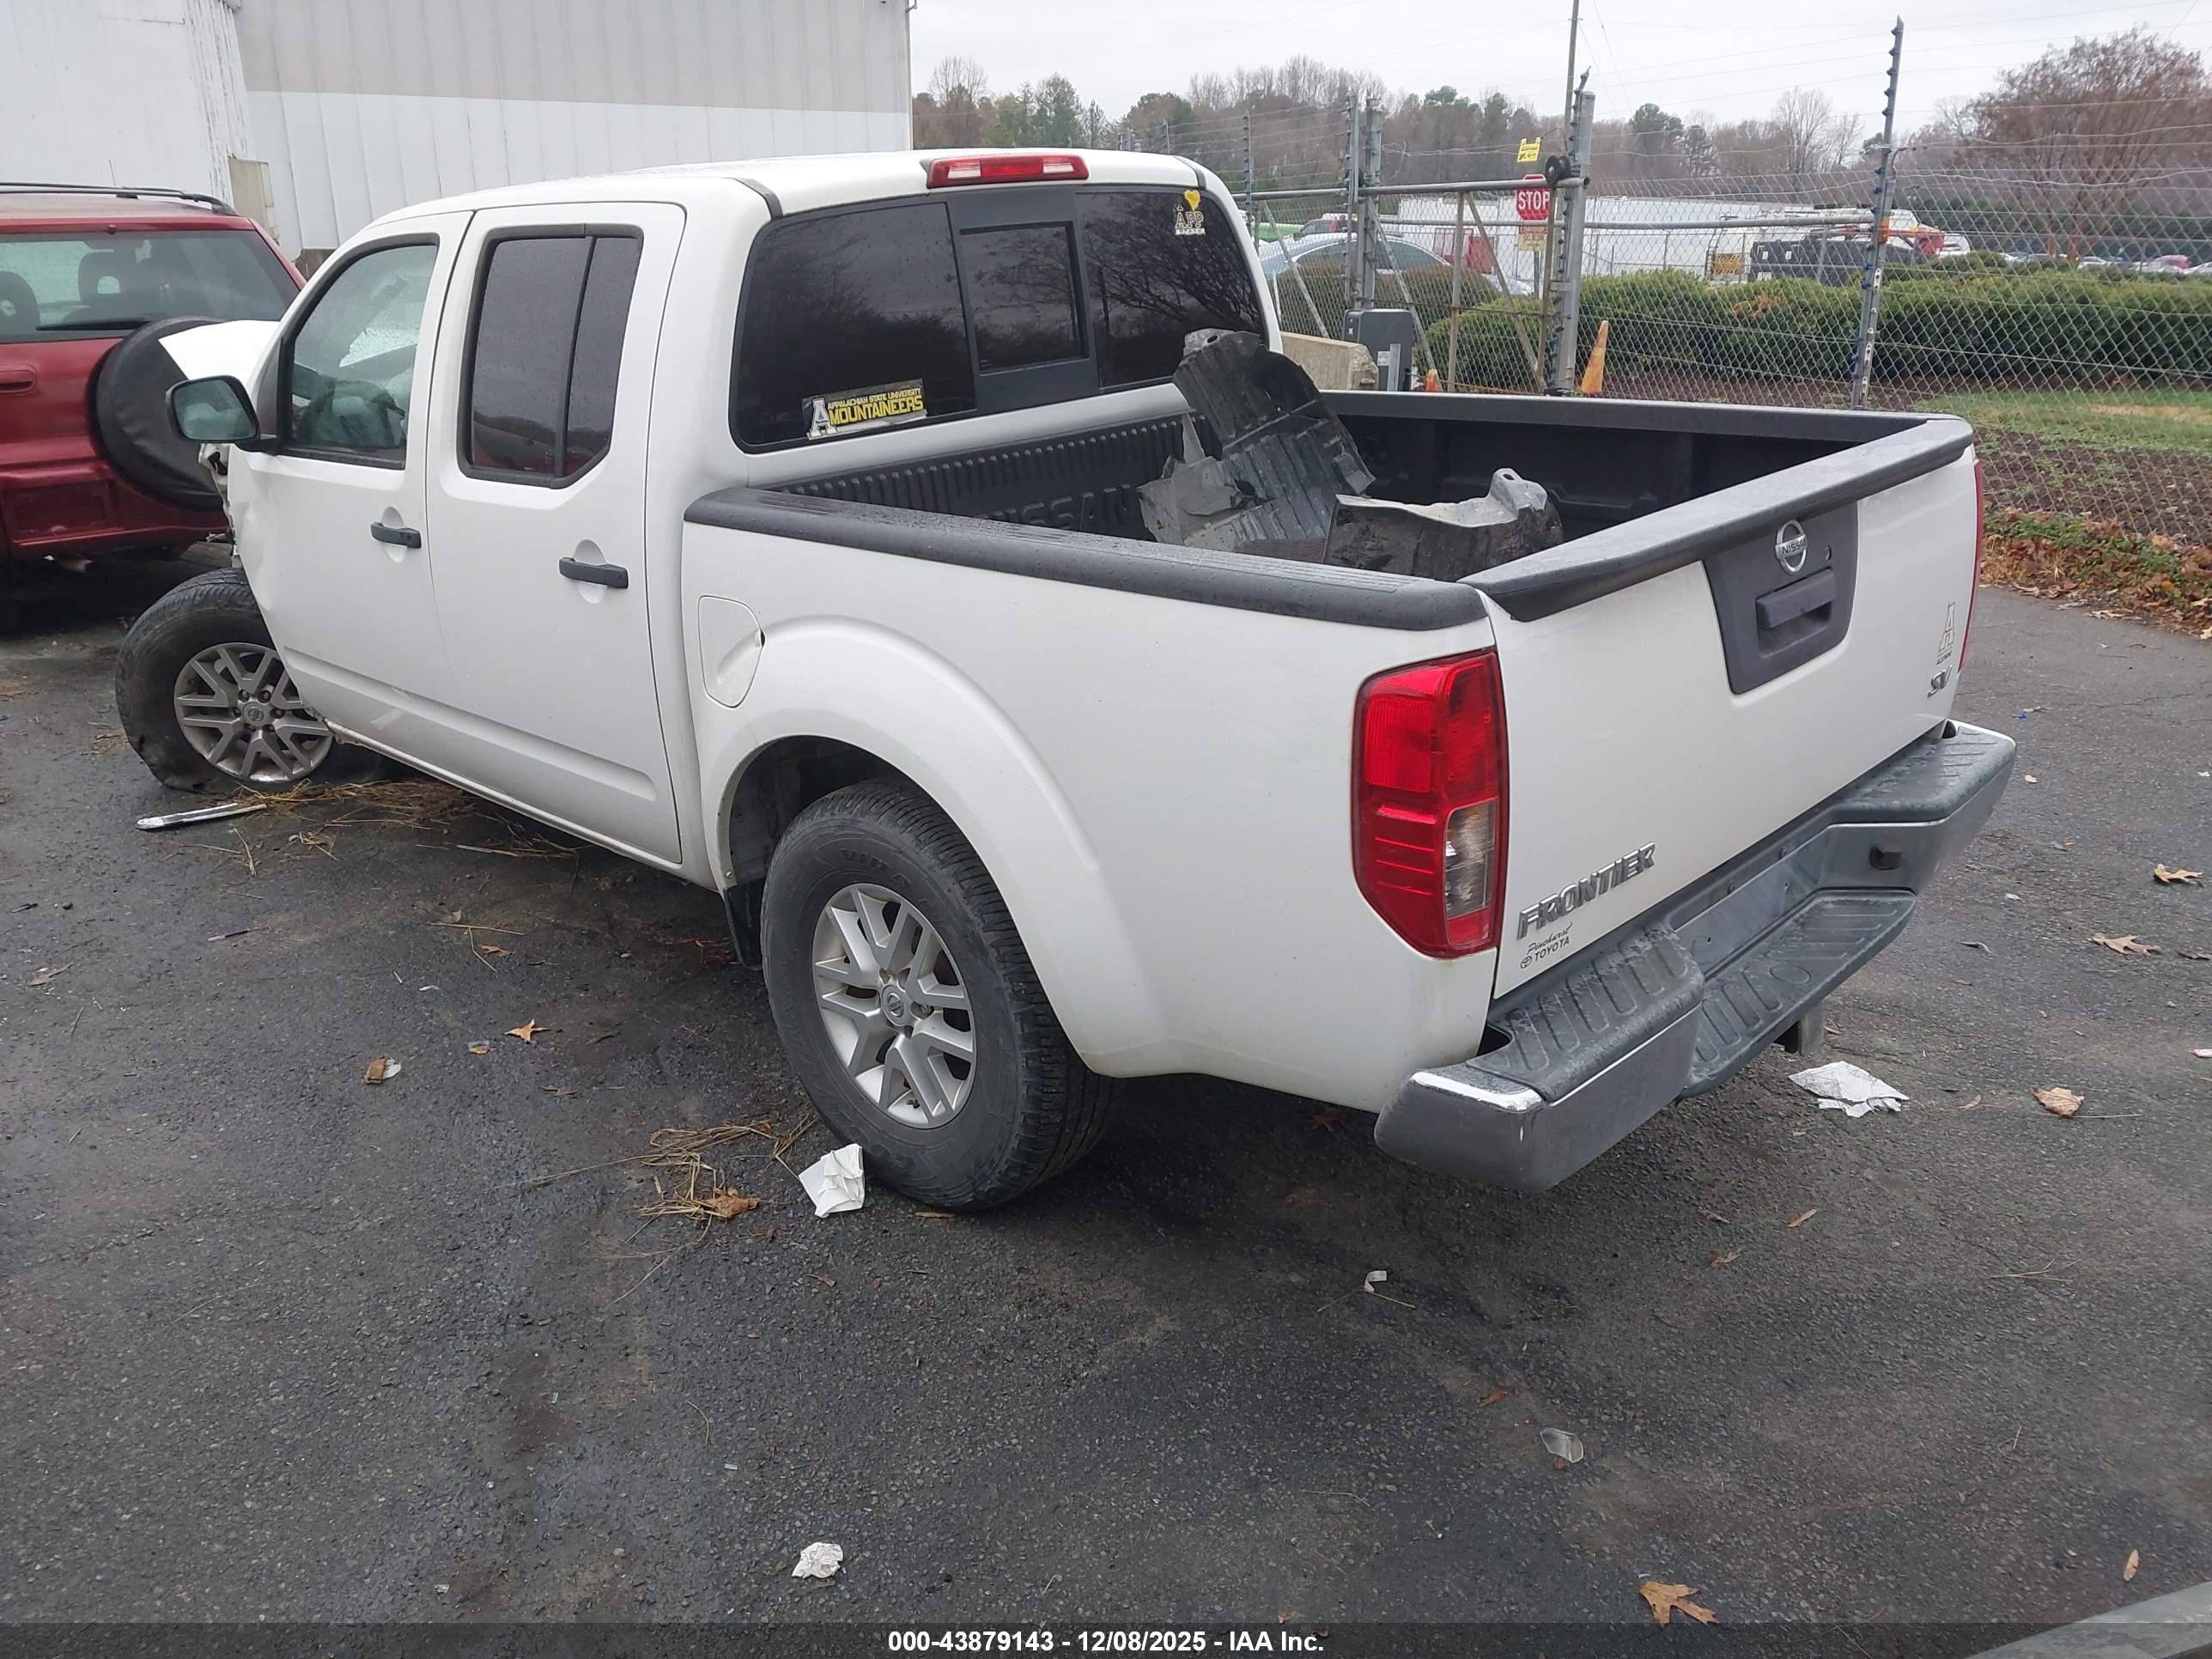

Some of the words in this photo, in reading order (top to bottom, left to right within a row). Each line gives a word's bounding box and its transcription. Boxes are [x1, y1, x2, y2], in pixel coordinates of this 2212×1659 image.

[1518, 191, 1550, 210] STOP
[1175, 210, 1204, 228] APP
[828, 396, 868, 410] APPALACHIAN
[869, 392, 888, 404] STATE
[887, 387, 921, 400] UNIVERSITY
[829, 394, 924, 425] MOUNTAINEERS
[810, 398, 838, 437] A
[1927, 664, 1954, 697] SV
[1517, 842, 1656, 940] FRONTIER
[1535, 936, 1570, 962] TOYOTA
